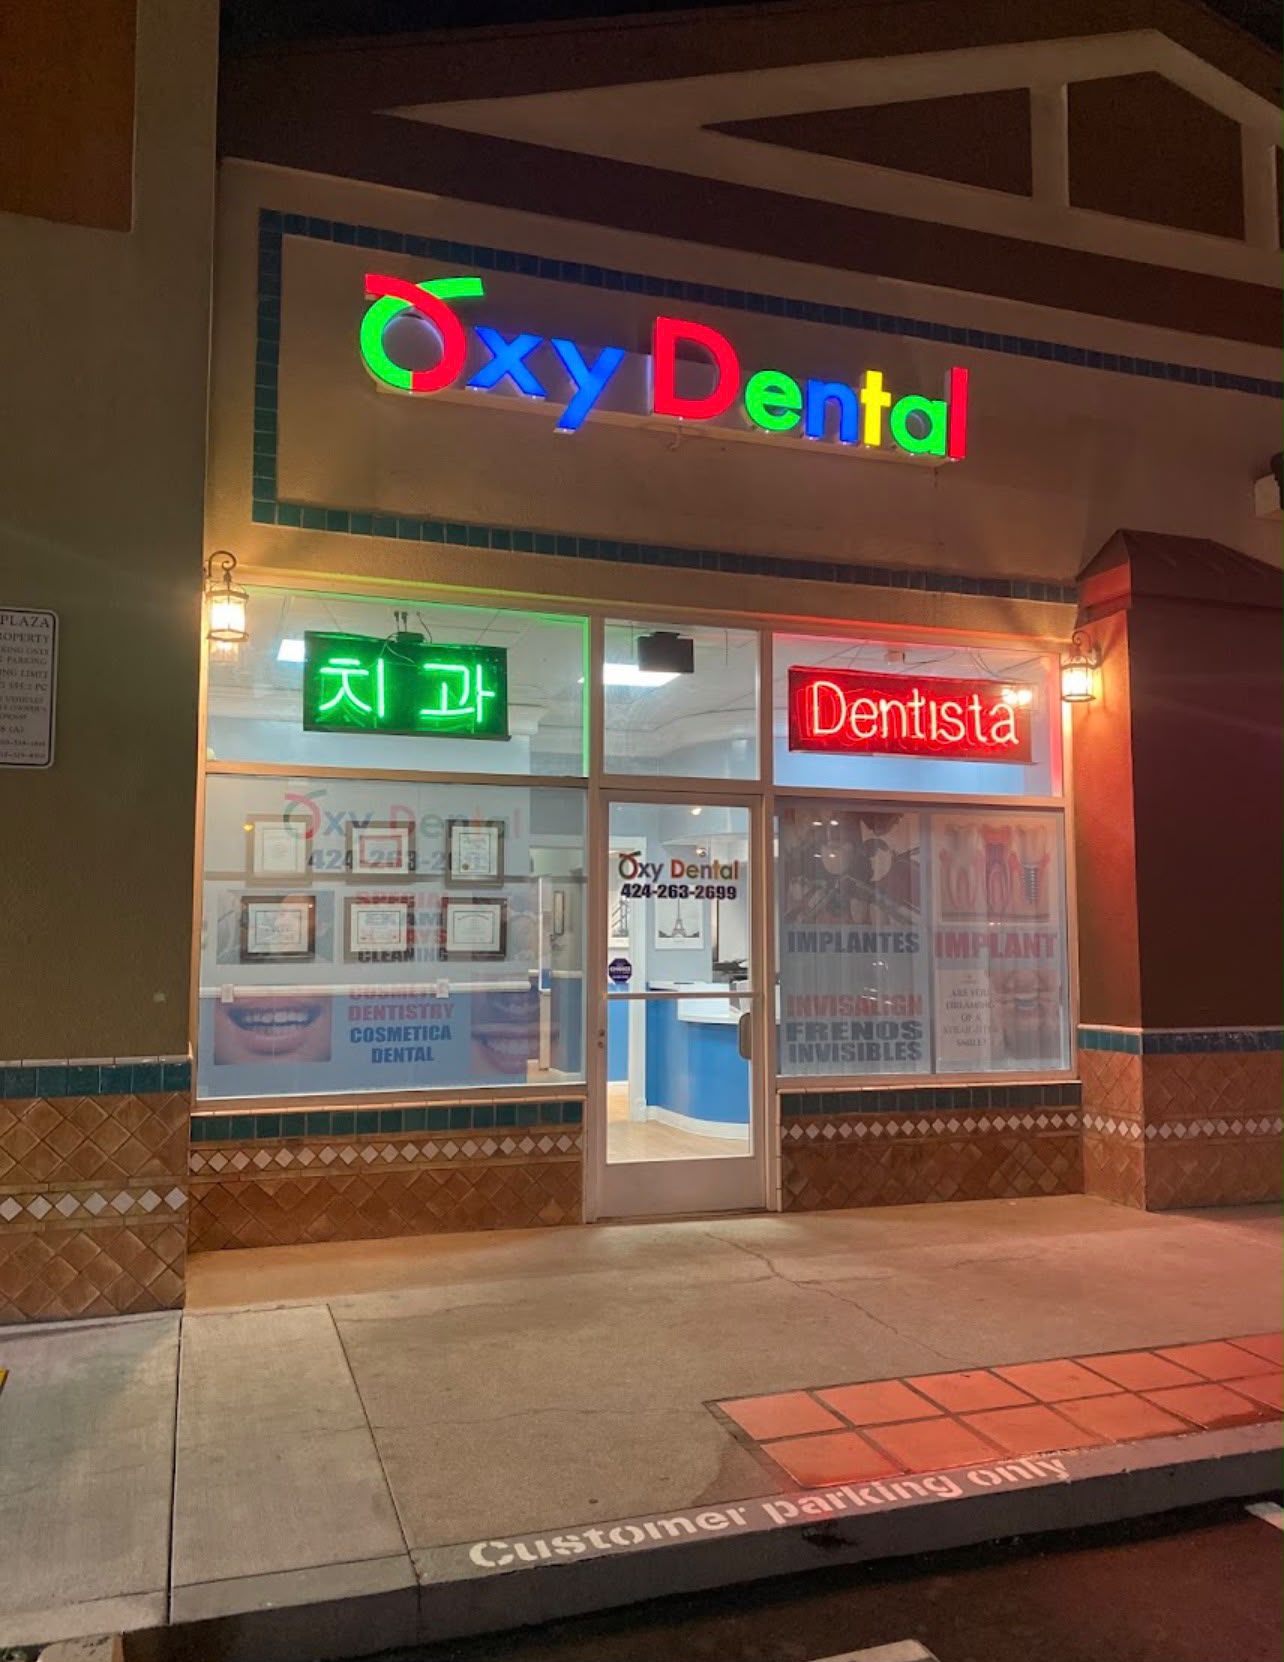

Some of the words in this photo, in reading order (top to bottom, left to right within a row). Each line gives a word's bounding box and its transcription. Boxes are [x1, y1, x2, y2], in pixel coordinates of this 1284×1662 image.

[360, 273, 625, 433] Oxy
[652, 316, 968, 460] Dental
[0, 614, 50, 629] PLAZA
[318, 657, 496, 724] 치과
[812, 681, 1020, 745] Dentista
[618, 851, 664, 883] Oxy
[671, 859, 739, 880] Dental
[620, 883, 738, 900] 424-263-2699
[787, 931, 920, 953] IMPLANTES
[935, 931, 1058, 959] IMPLANT
[347, 1003, 455, 1021] DENTISTRY
[350, 1024, 452, 1044] COSMETICA
[785, 1020, 923, 1042] FRENOS
[371, 1046, 435, 1064] DENTAL
[788, 1042, 923, 1064] INVISIBLES
[468, 1504, 748, 1569] Customer
[761, 1474, 964, 1526] parking
[966, 1453, 1071, 1486] only
